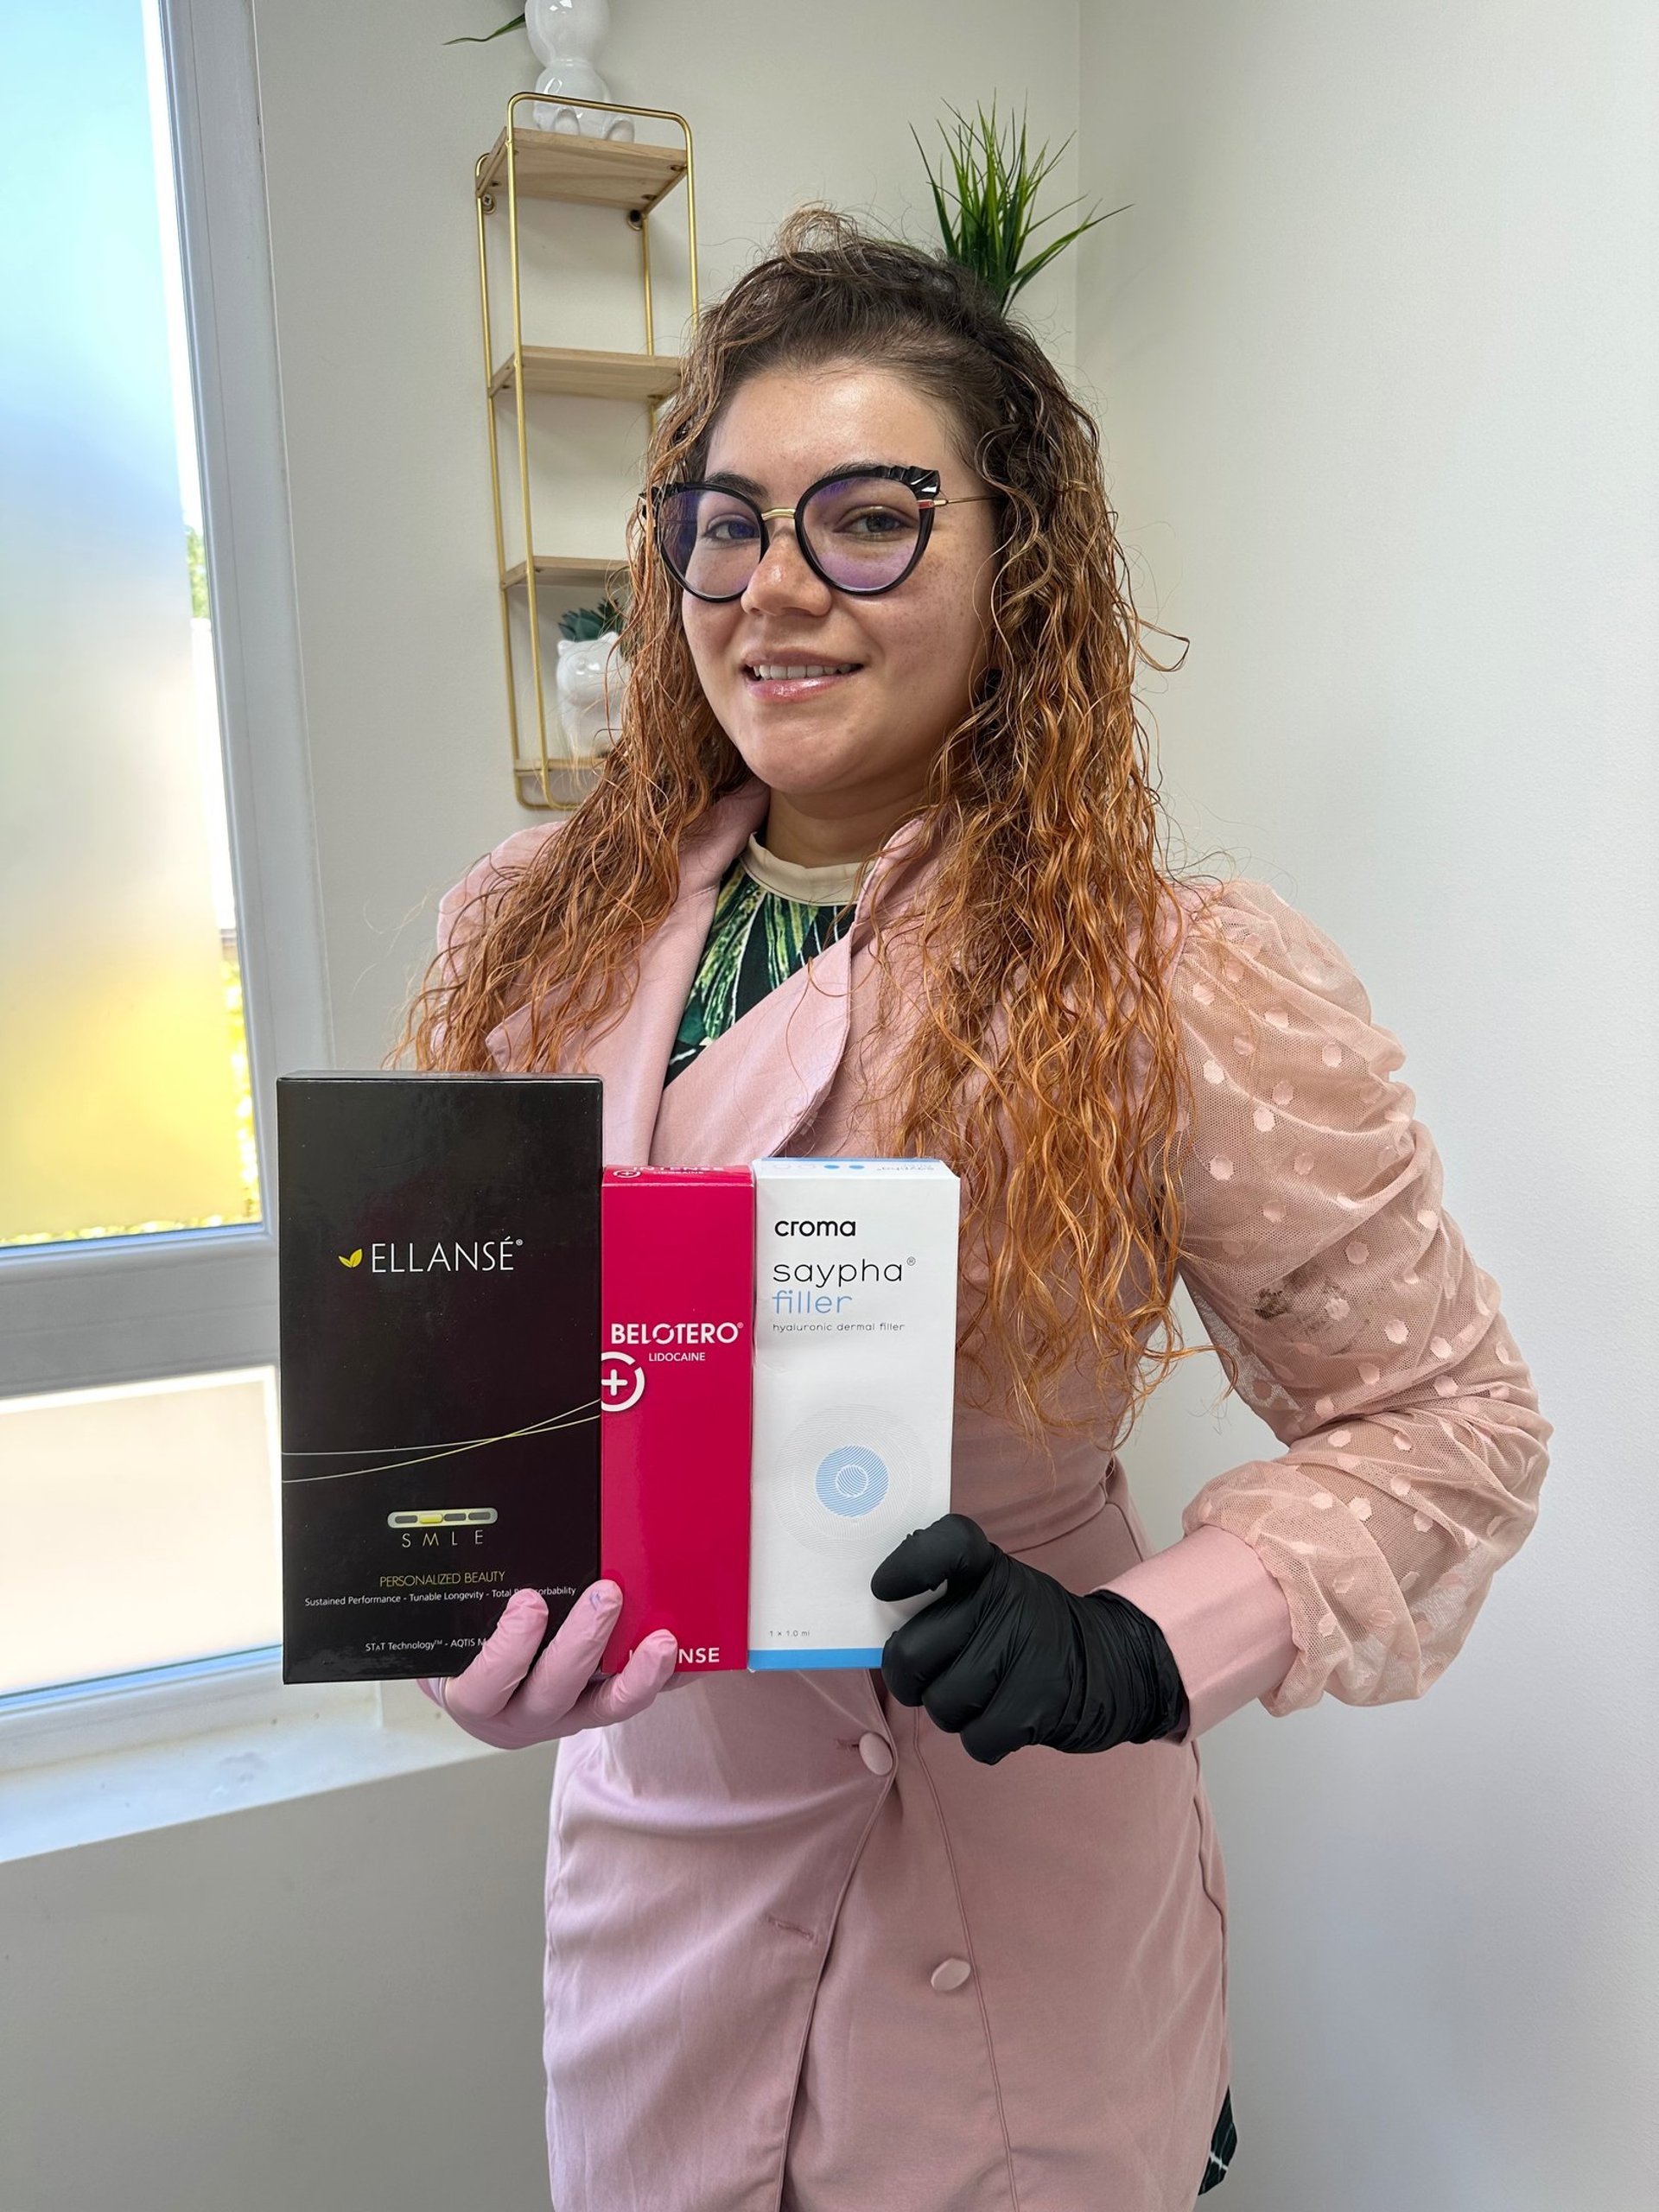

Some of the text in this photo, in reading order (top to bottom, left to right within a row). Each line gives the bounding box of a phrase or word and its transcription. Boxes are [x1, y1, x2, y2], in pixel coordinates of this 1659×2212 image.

[774, 1220, 855, 1236] croma
[772, 1290, 853, 1313] filler
[772, 1322, 905, 1333] hyaluronic dermal filler
[649, 1352, 706, 1362] LIDOCAINE
[380, 1571, 505, 1587] PERSONALIZED BEAUTY
[304, 1597, 346, 1607] Sustained
[348, 1595, 401, 1605] Performance
[410, 1592, 442, 1602] Tunable
[444, 1592, 484, 1602] Longevity
[492, 1589, 512, 1599] Total
[450, 1638, 476, 1649] AQTIS
[629, 1647, 720, 1664] INSE
